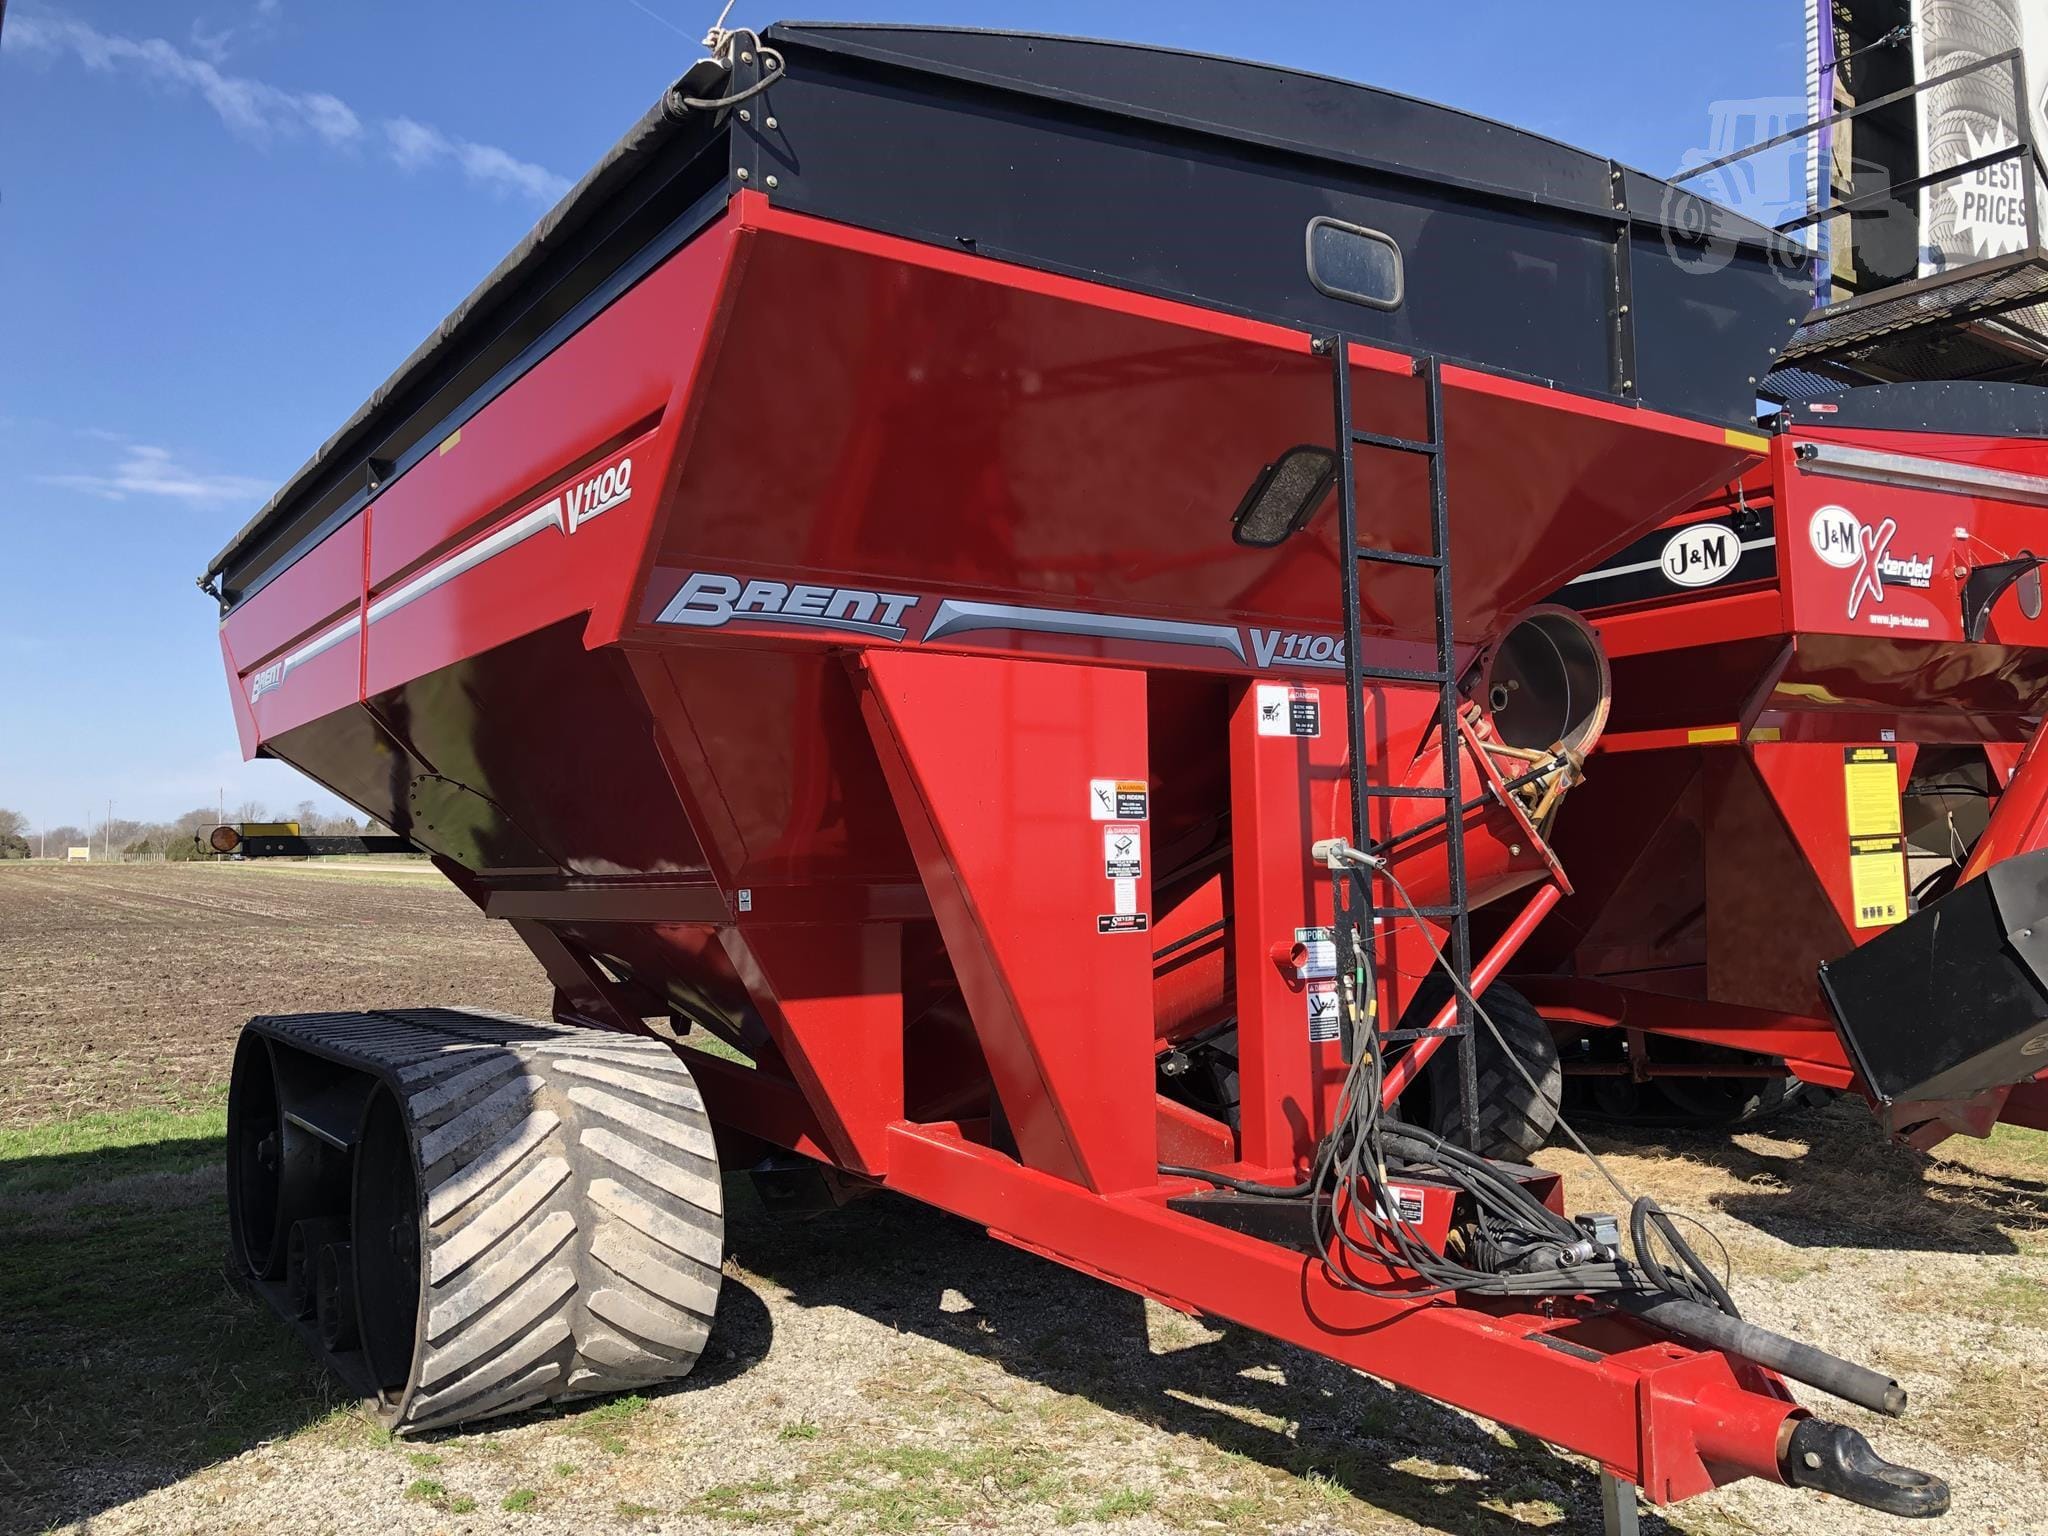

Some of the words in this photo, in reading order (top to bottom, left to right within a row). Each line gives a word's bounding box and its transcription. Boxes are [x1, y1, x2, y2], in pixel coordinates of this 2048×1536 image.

[1975, 162, 2019, 190] BEST
[1963, 191, 2026, 227] PRICES
[565, 457, 632, 536] V1100
[1816, 519, 1856, 554] J&M
[1669, 535, 1727, 576] J&M
[654, 571, 921, 630] BRENT
[1869, 614, 1929, 628] www.jm-inc.com
